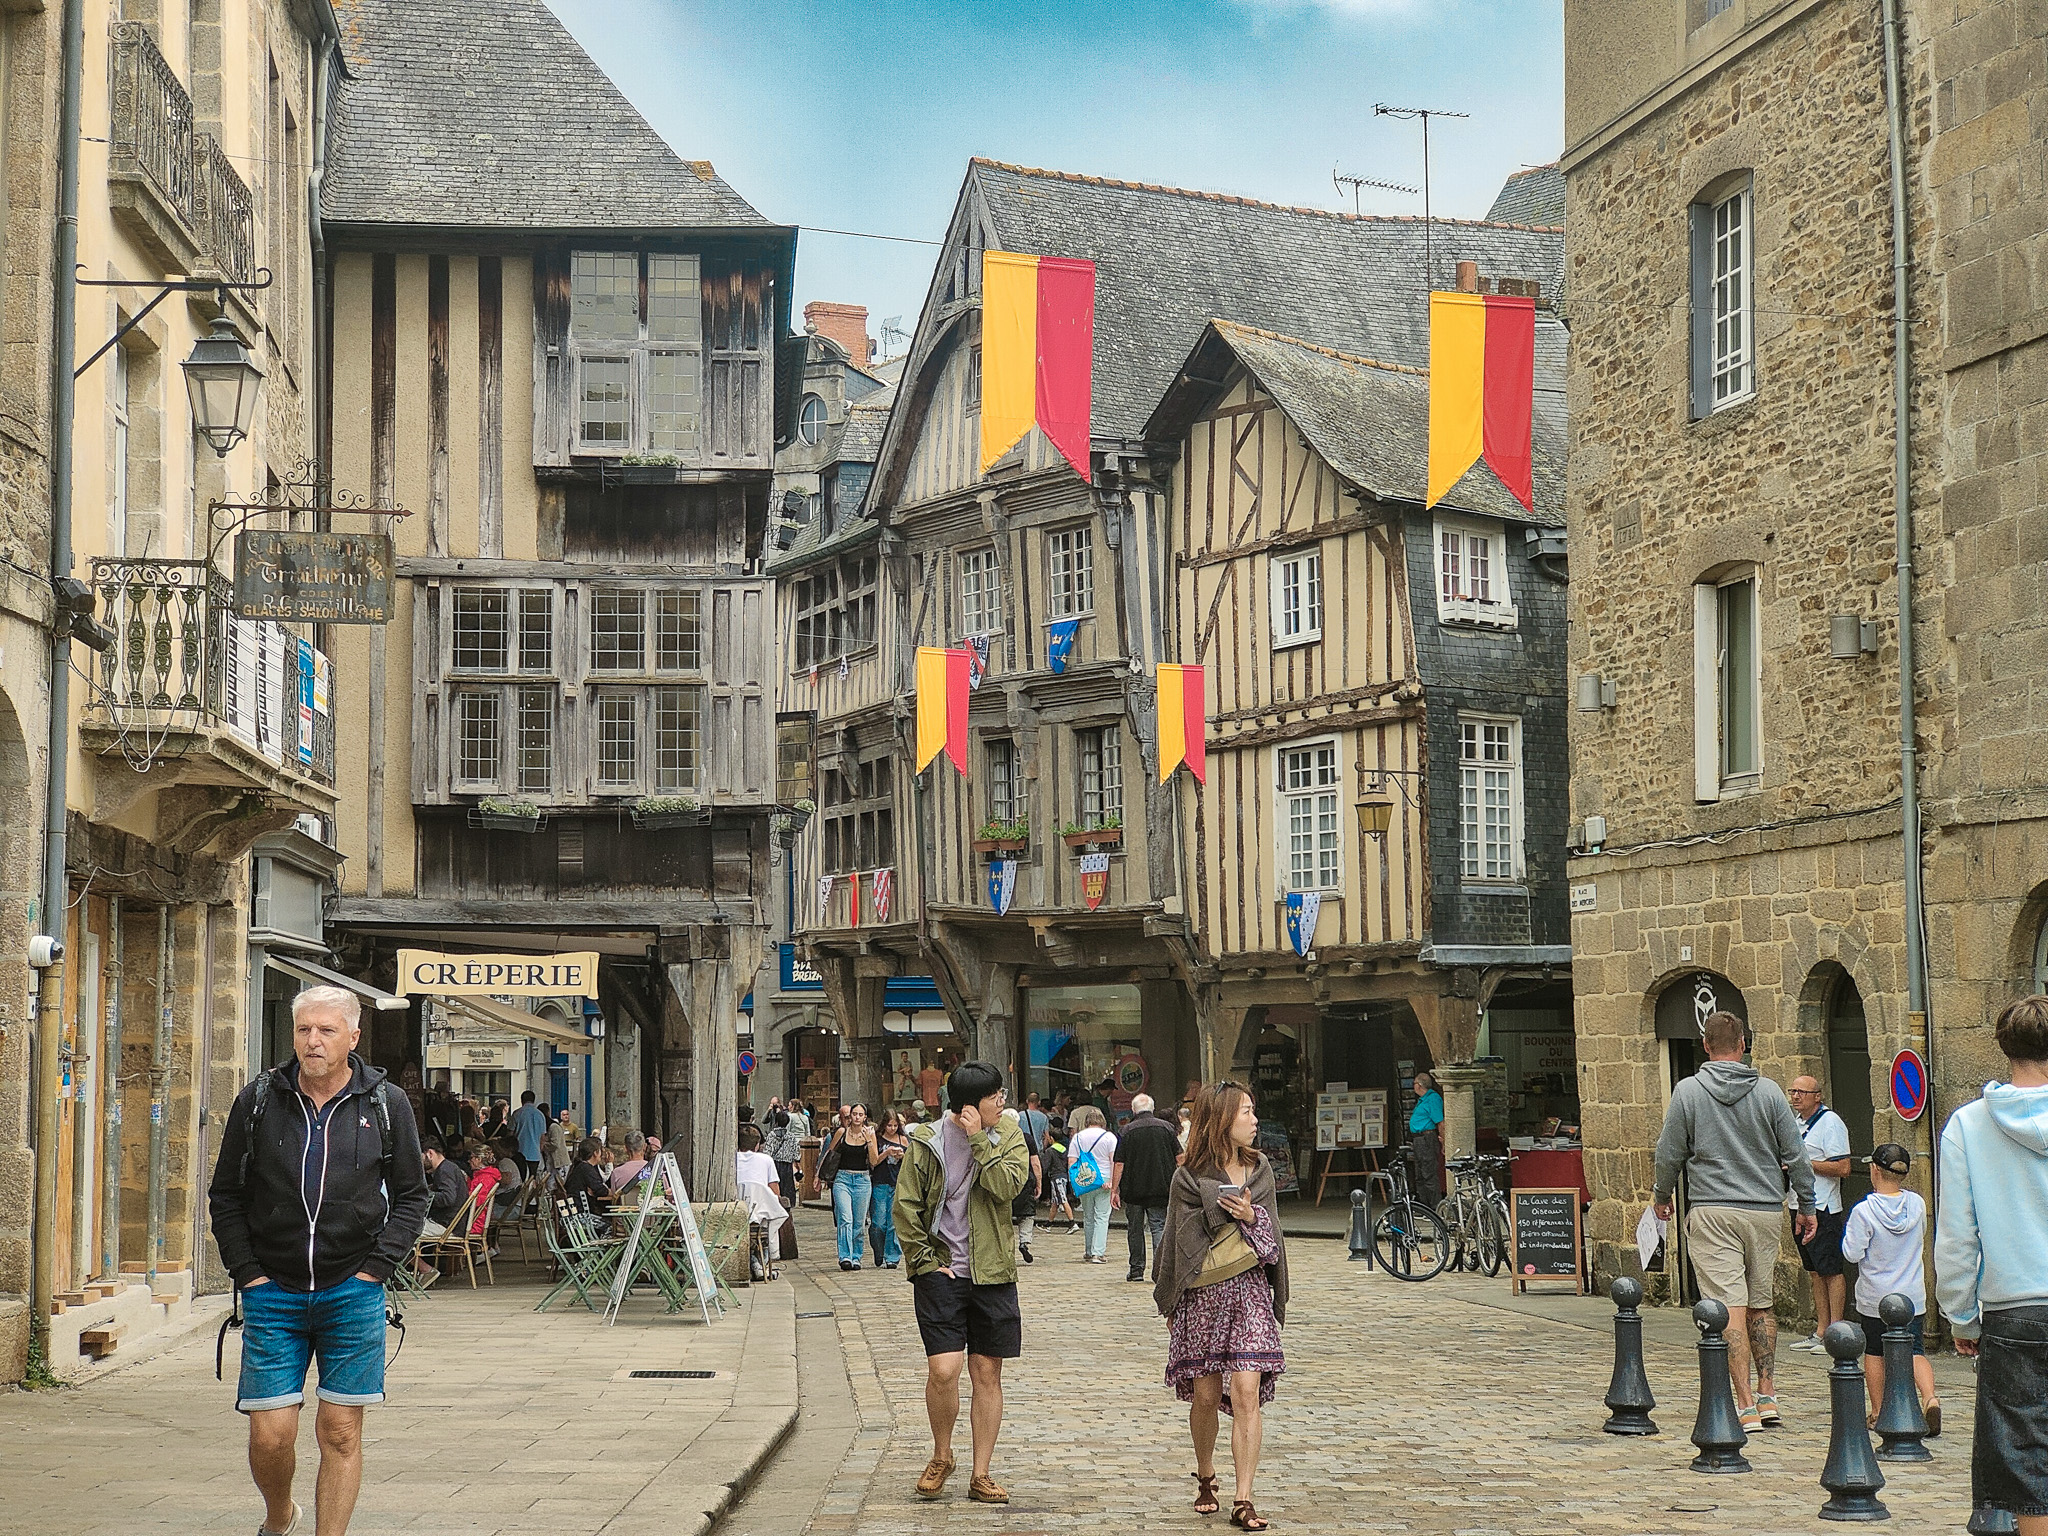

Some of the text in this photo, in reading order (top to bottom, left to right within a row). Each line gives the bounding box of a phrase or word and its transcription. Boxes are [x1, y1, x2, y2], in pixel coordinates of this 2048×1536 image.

[413, 959, 582, 986] CRÊPERIE
[1524, 1036, 1573, 1046] BOUQUINE
[1549, 1047, 1563, 1056] DU
[1539, 1058, 1574, 1067] CENTRE
[1518, 1195, 1567, 1206] La Cave des
[1531, 1207, 1563, 1215] Oiseaux
[1517, 1219, 1531, 1227] 150
[1565, 1218, 1574, 1226] de
[1519, 1241, 1527, 1249] et
